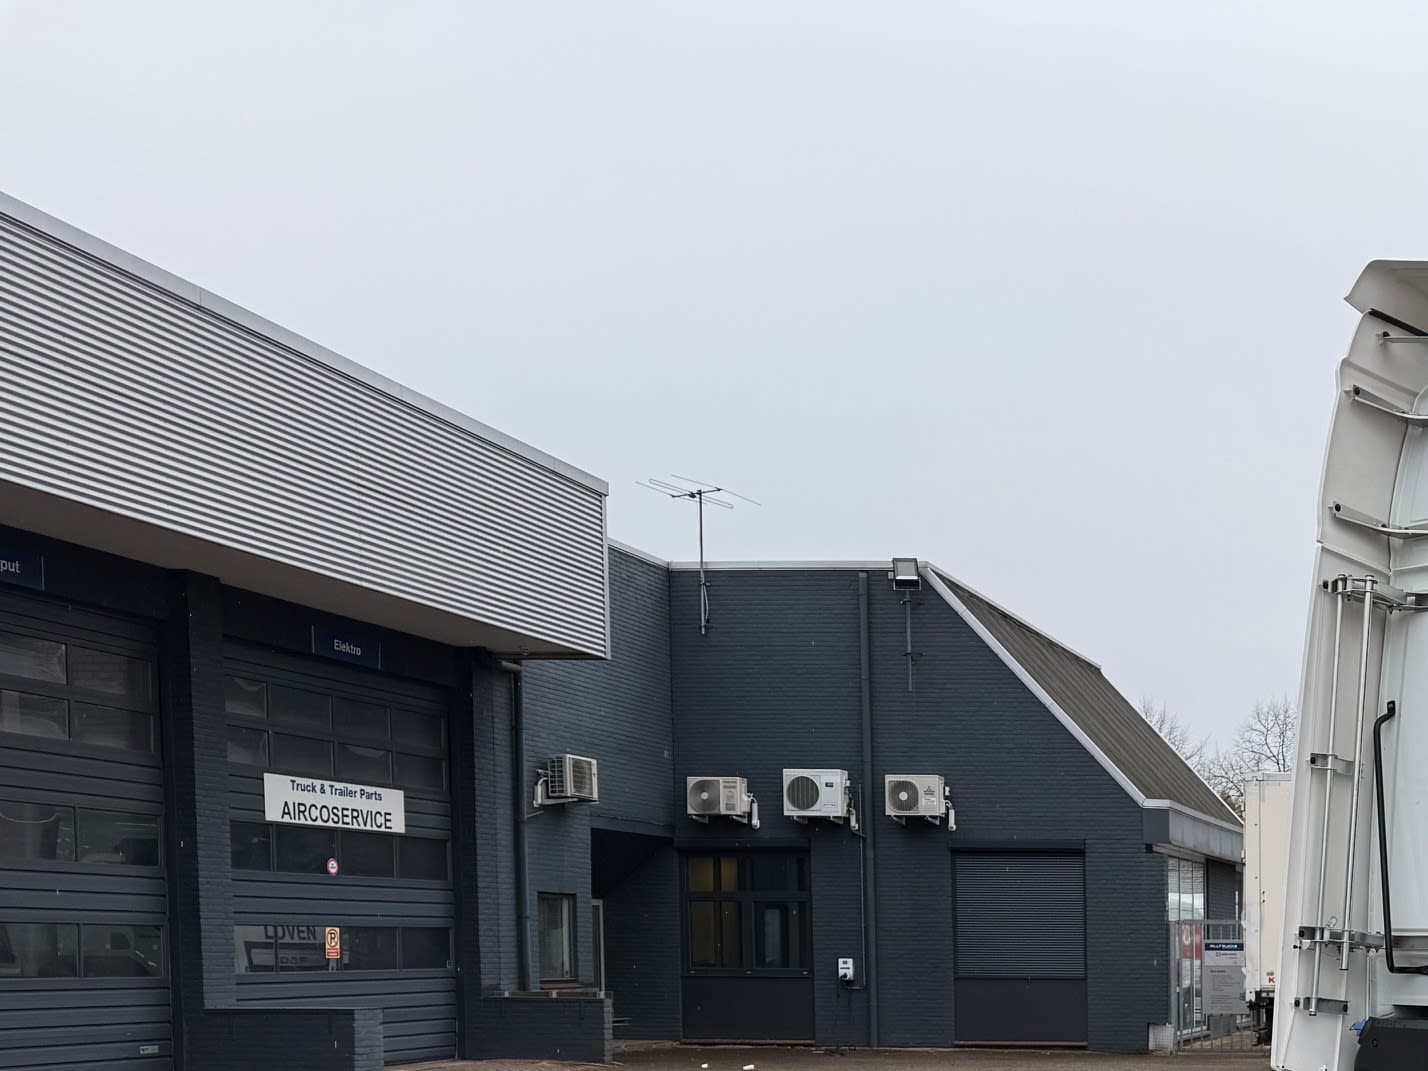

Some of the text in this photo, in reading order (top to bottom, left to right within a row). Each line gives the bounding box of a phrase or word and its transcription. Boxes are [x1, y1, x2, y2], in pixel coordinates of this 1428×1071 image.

[334, 639, 362, 656] Elektro
[290, 779, 383, 801] Truck & Trailer Parts
[281, 800, 393, 830] AIRCOSERVICE
